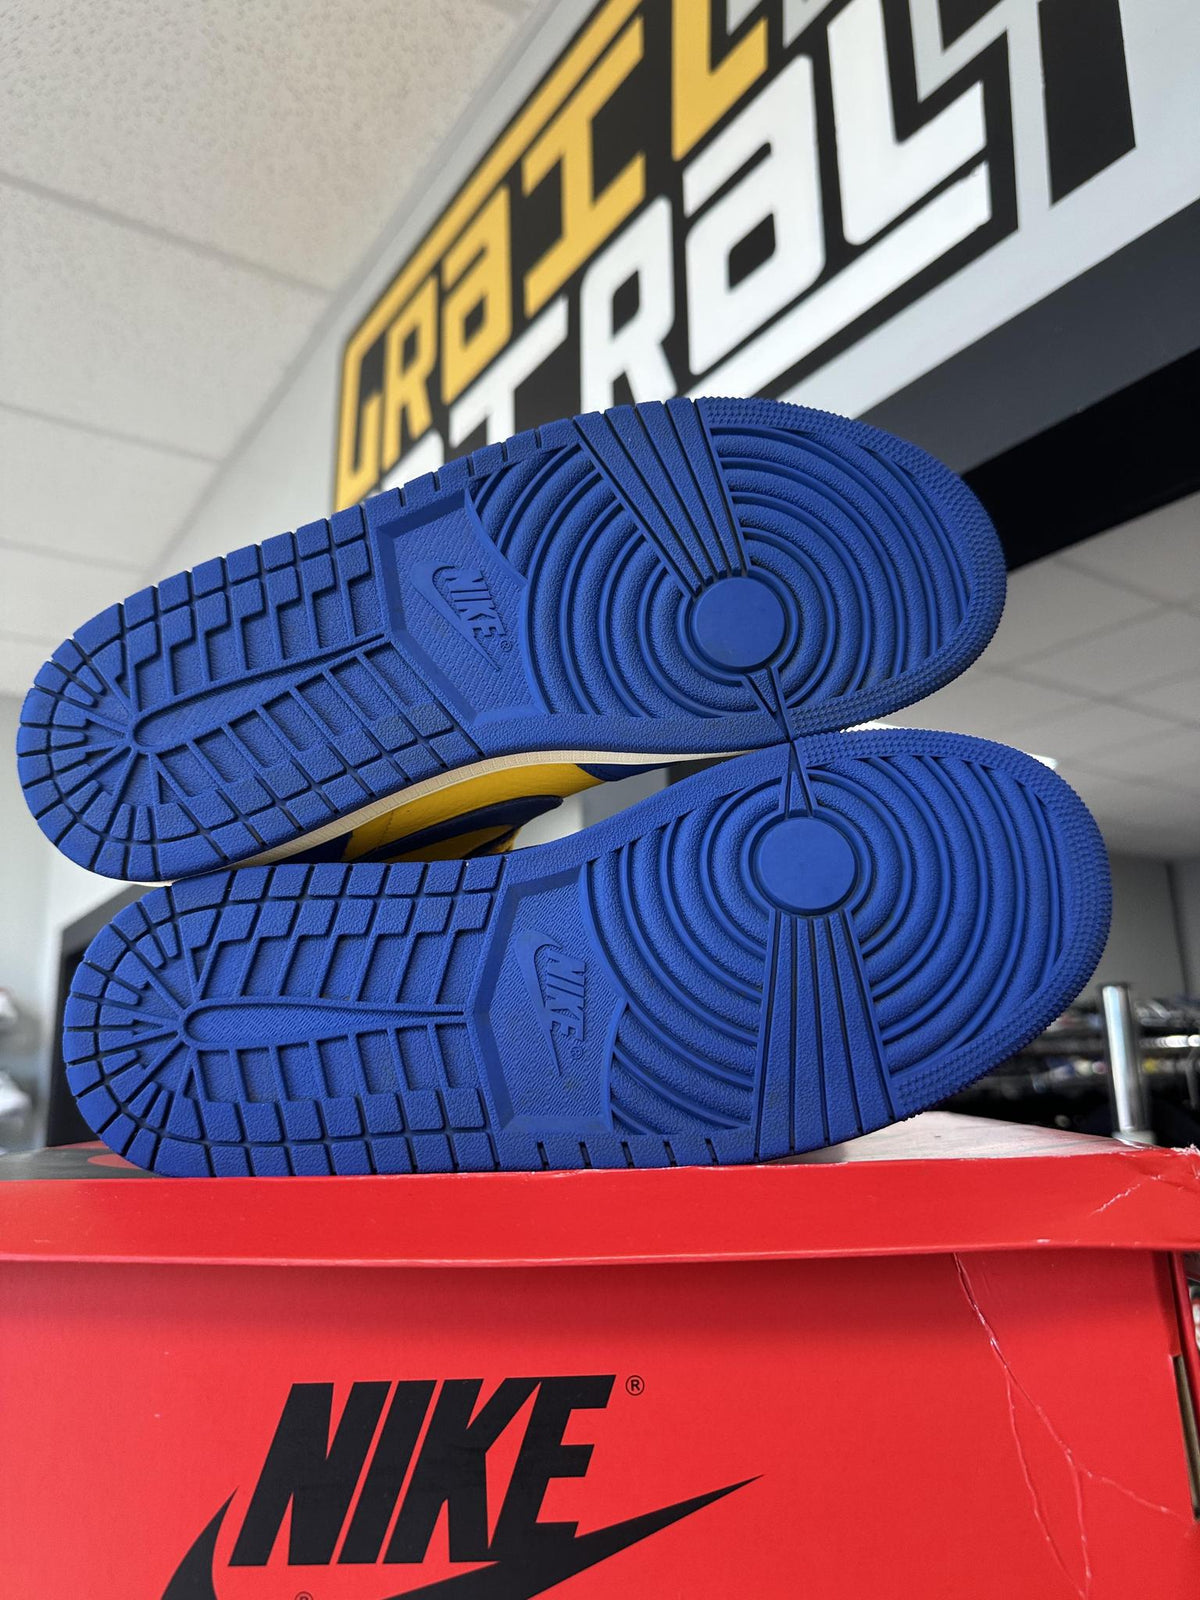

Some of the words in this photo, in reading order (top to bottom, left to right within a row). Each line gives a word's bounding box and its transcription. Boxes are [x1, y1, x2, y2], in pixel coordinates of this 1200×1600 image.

[441, 566, 507, 639] NIKE
[546, 949, 586, 1042] NIKE
[227, 1374, 617, 1566] NIKE
